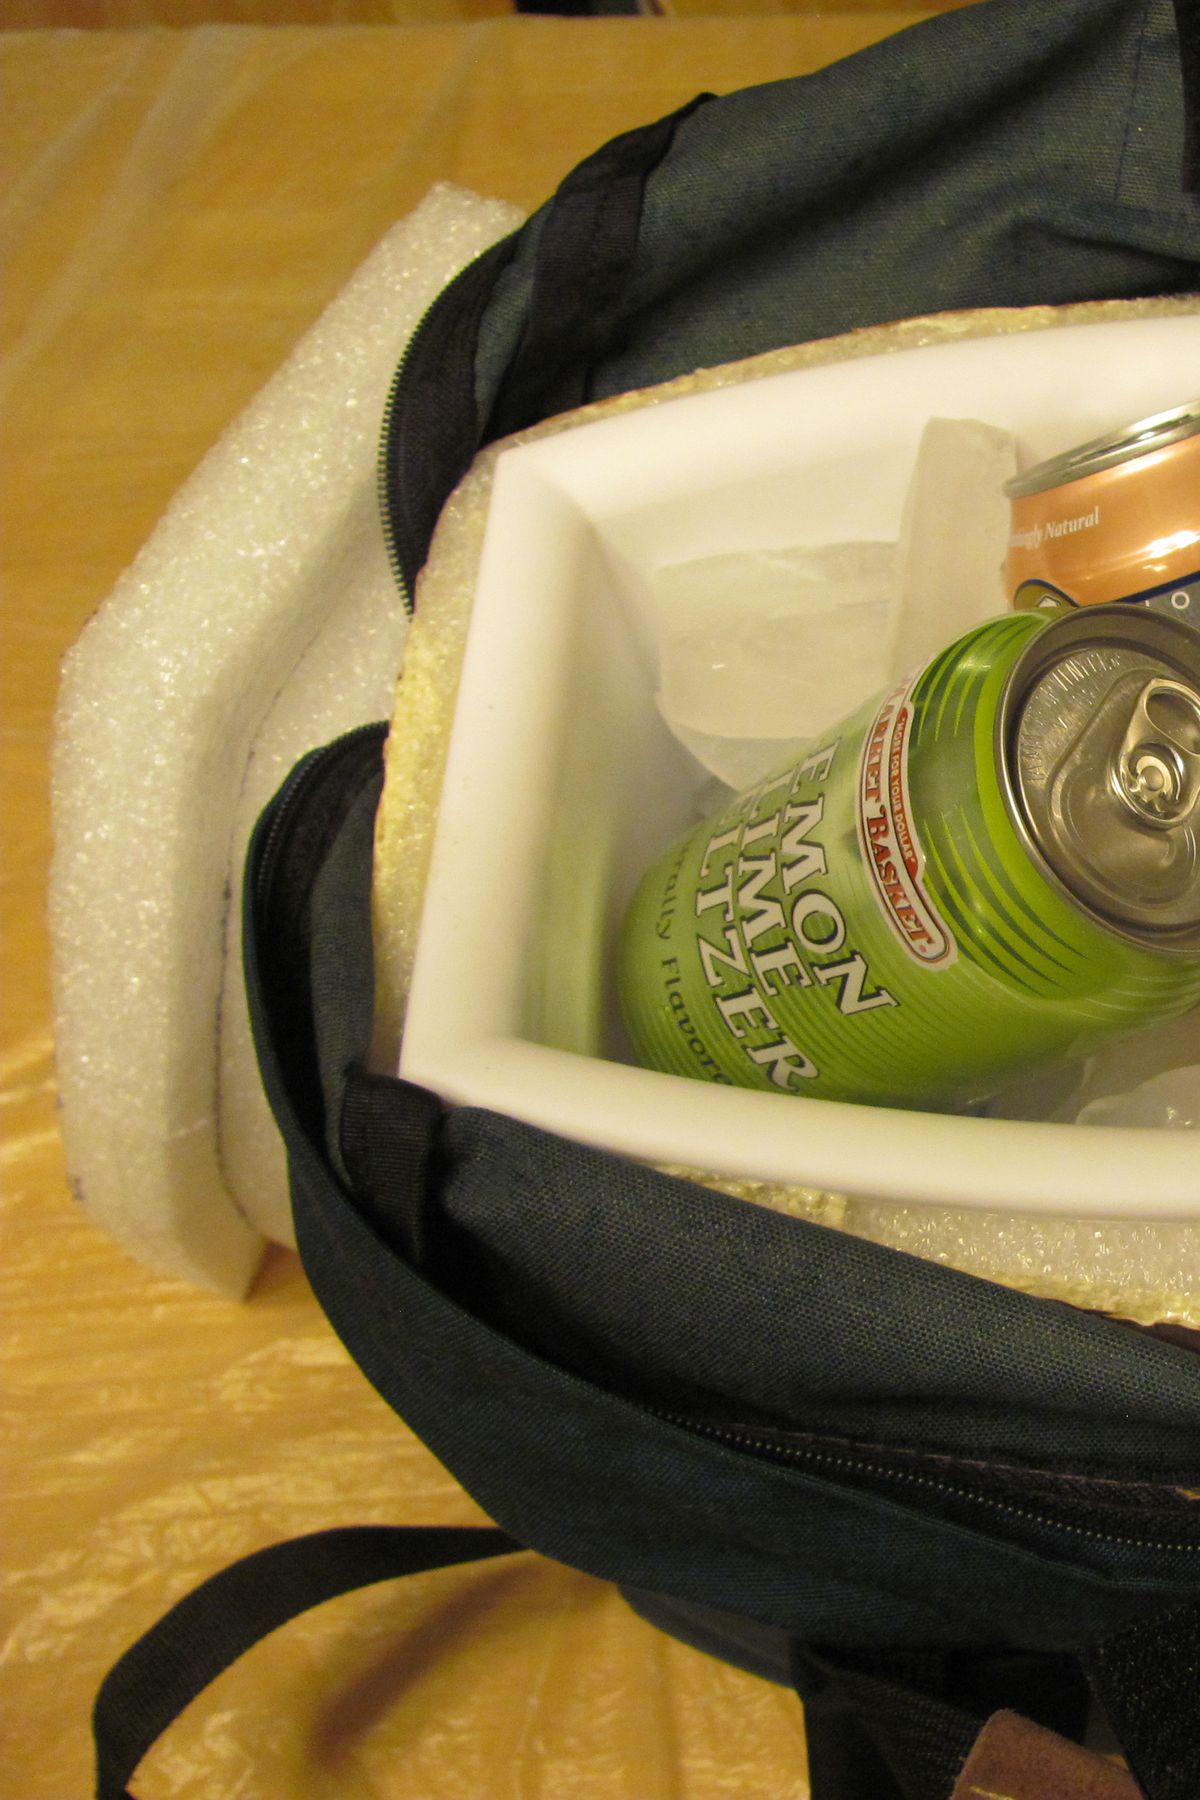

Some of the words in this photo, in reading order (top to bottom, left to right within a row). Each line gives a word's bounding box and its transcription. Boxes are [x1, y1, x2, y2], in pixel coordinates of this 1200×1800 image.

[889, 754, 900, 777] FOR
[889, 777, 903, 812] YOUR
[781, 736, 900, 1016] EMON
[866, 804, 935, 946] BASKET
